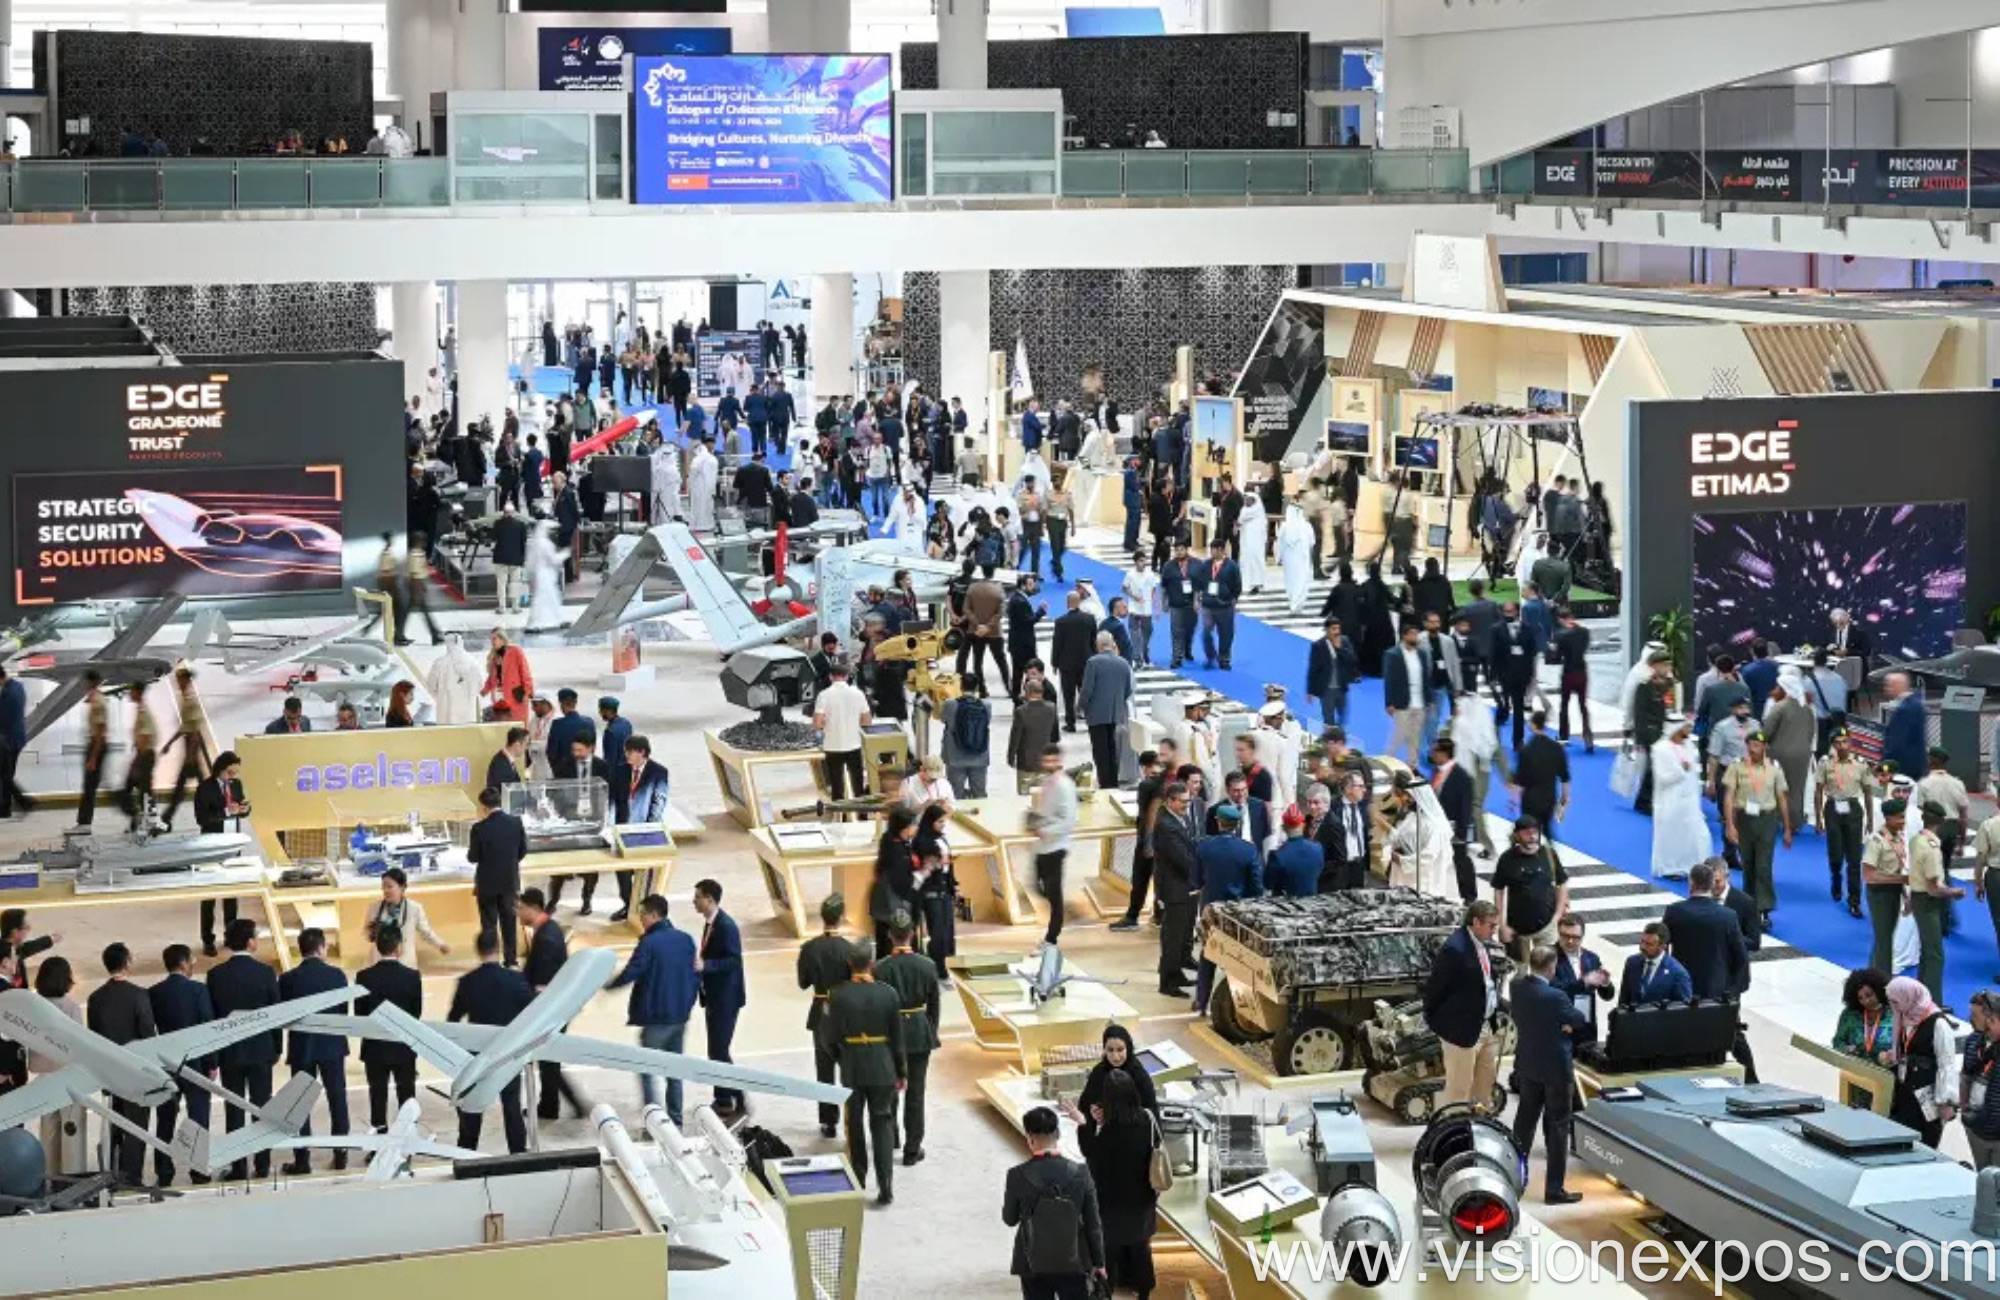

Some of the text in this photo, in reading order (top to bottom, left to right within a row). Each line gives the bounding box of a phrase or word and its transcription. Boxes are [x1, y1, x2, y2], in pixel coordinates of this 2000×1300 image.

[667, 133, 715, 147] Bridging
[1546, 166, 1576, 182] EDGE
[1888, 158, 1958, 171] PRECISION AT
[1888, 175, 1920, 189] EVERY
[127, 383, 222, 411] EDGE
[128, 414, 222, 430] GRADEONE
[128, 436, 184, 451] TRUST
[1692, 430, 1790, 463] EDGE
[1692, 471, 1790, 497] ETIMAD
[38, 498, 156, 518] STRATEGIC
[38, 523, 144, 543] SECURITY
[39, 546, 166, 568] SOLUTIONS
[296, 752, 471, 793] aselsan
